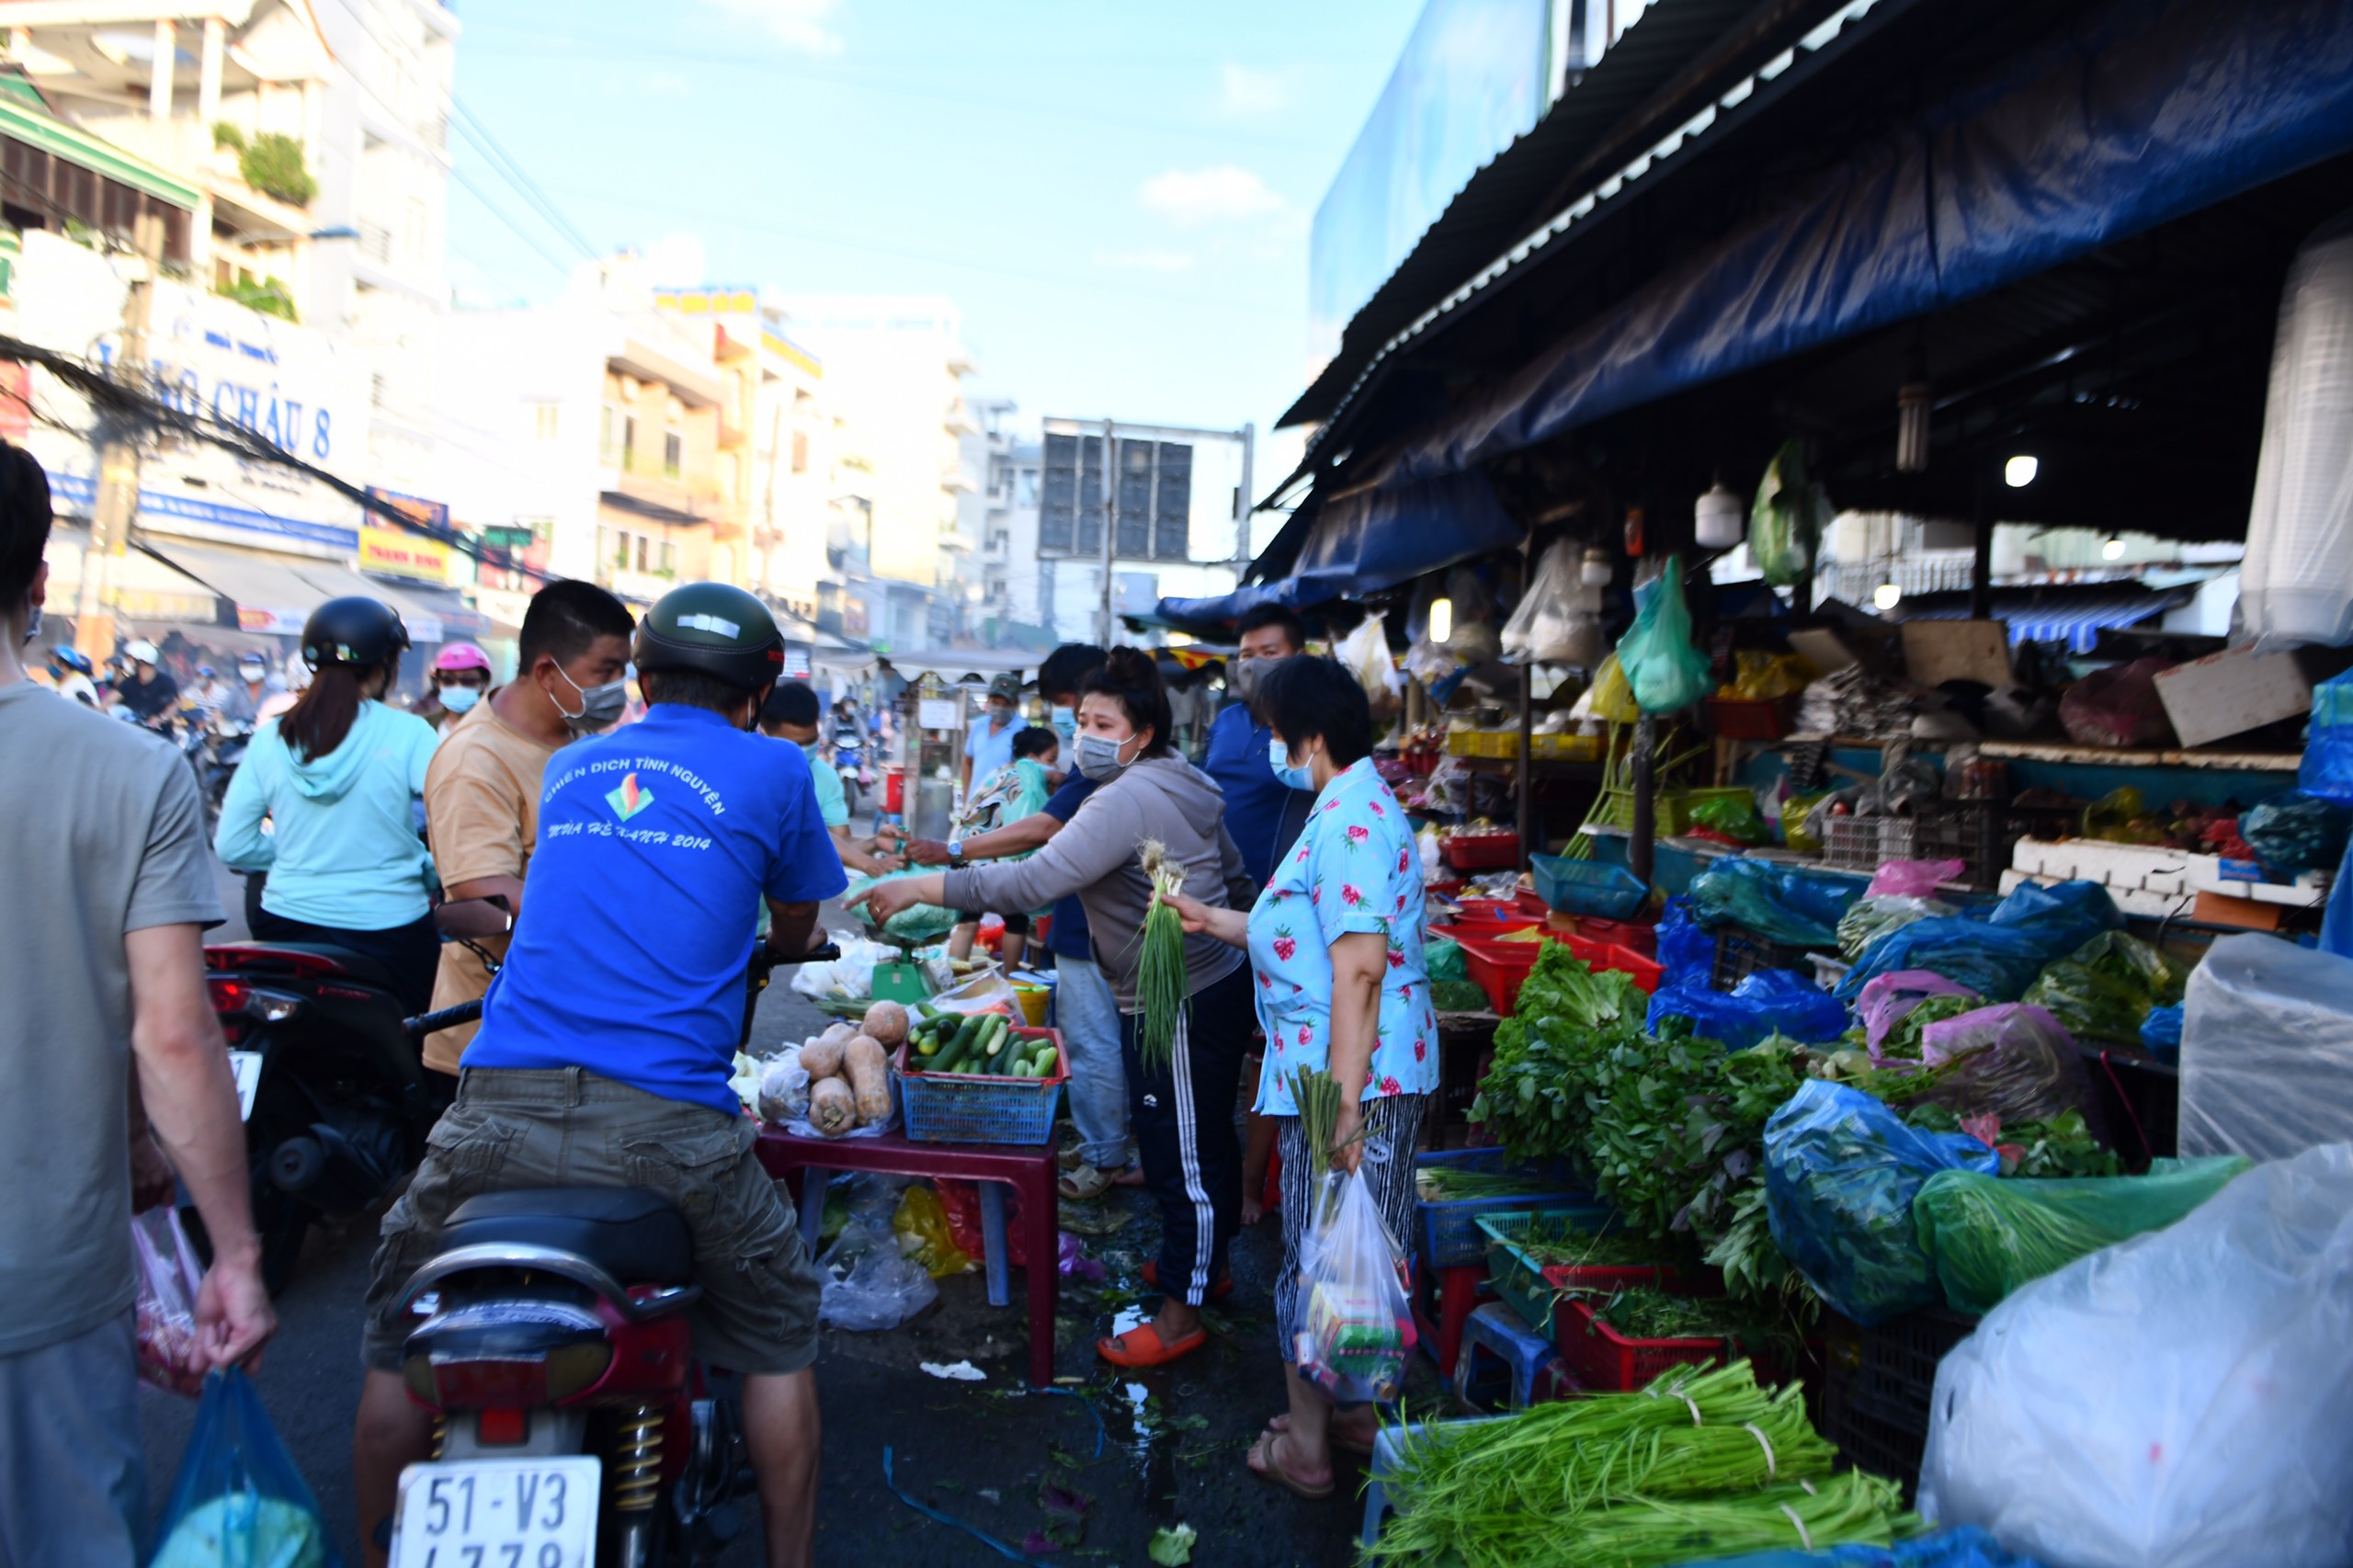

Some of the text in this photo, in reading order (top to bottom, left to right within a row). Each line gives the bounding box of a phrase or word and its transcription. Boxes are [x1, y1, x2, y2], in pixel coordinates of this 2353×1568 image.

[313, 407, 331, 460] 8
[591, 758, 631, 774] DỊCH
[635, 756, 670, 773] TÌNH
[670, 764, 726, 816] NGUYỆN
[671, 834, 712, 851] 2014
[426, 1472, 567, 1537] 51-V3
